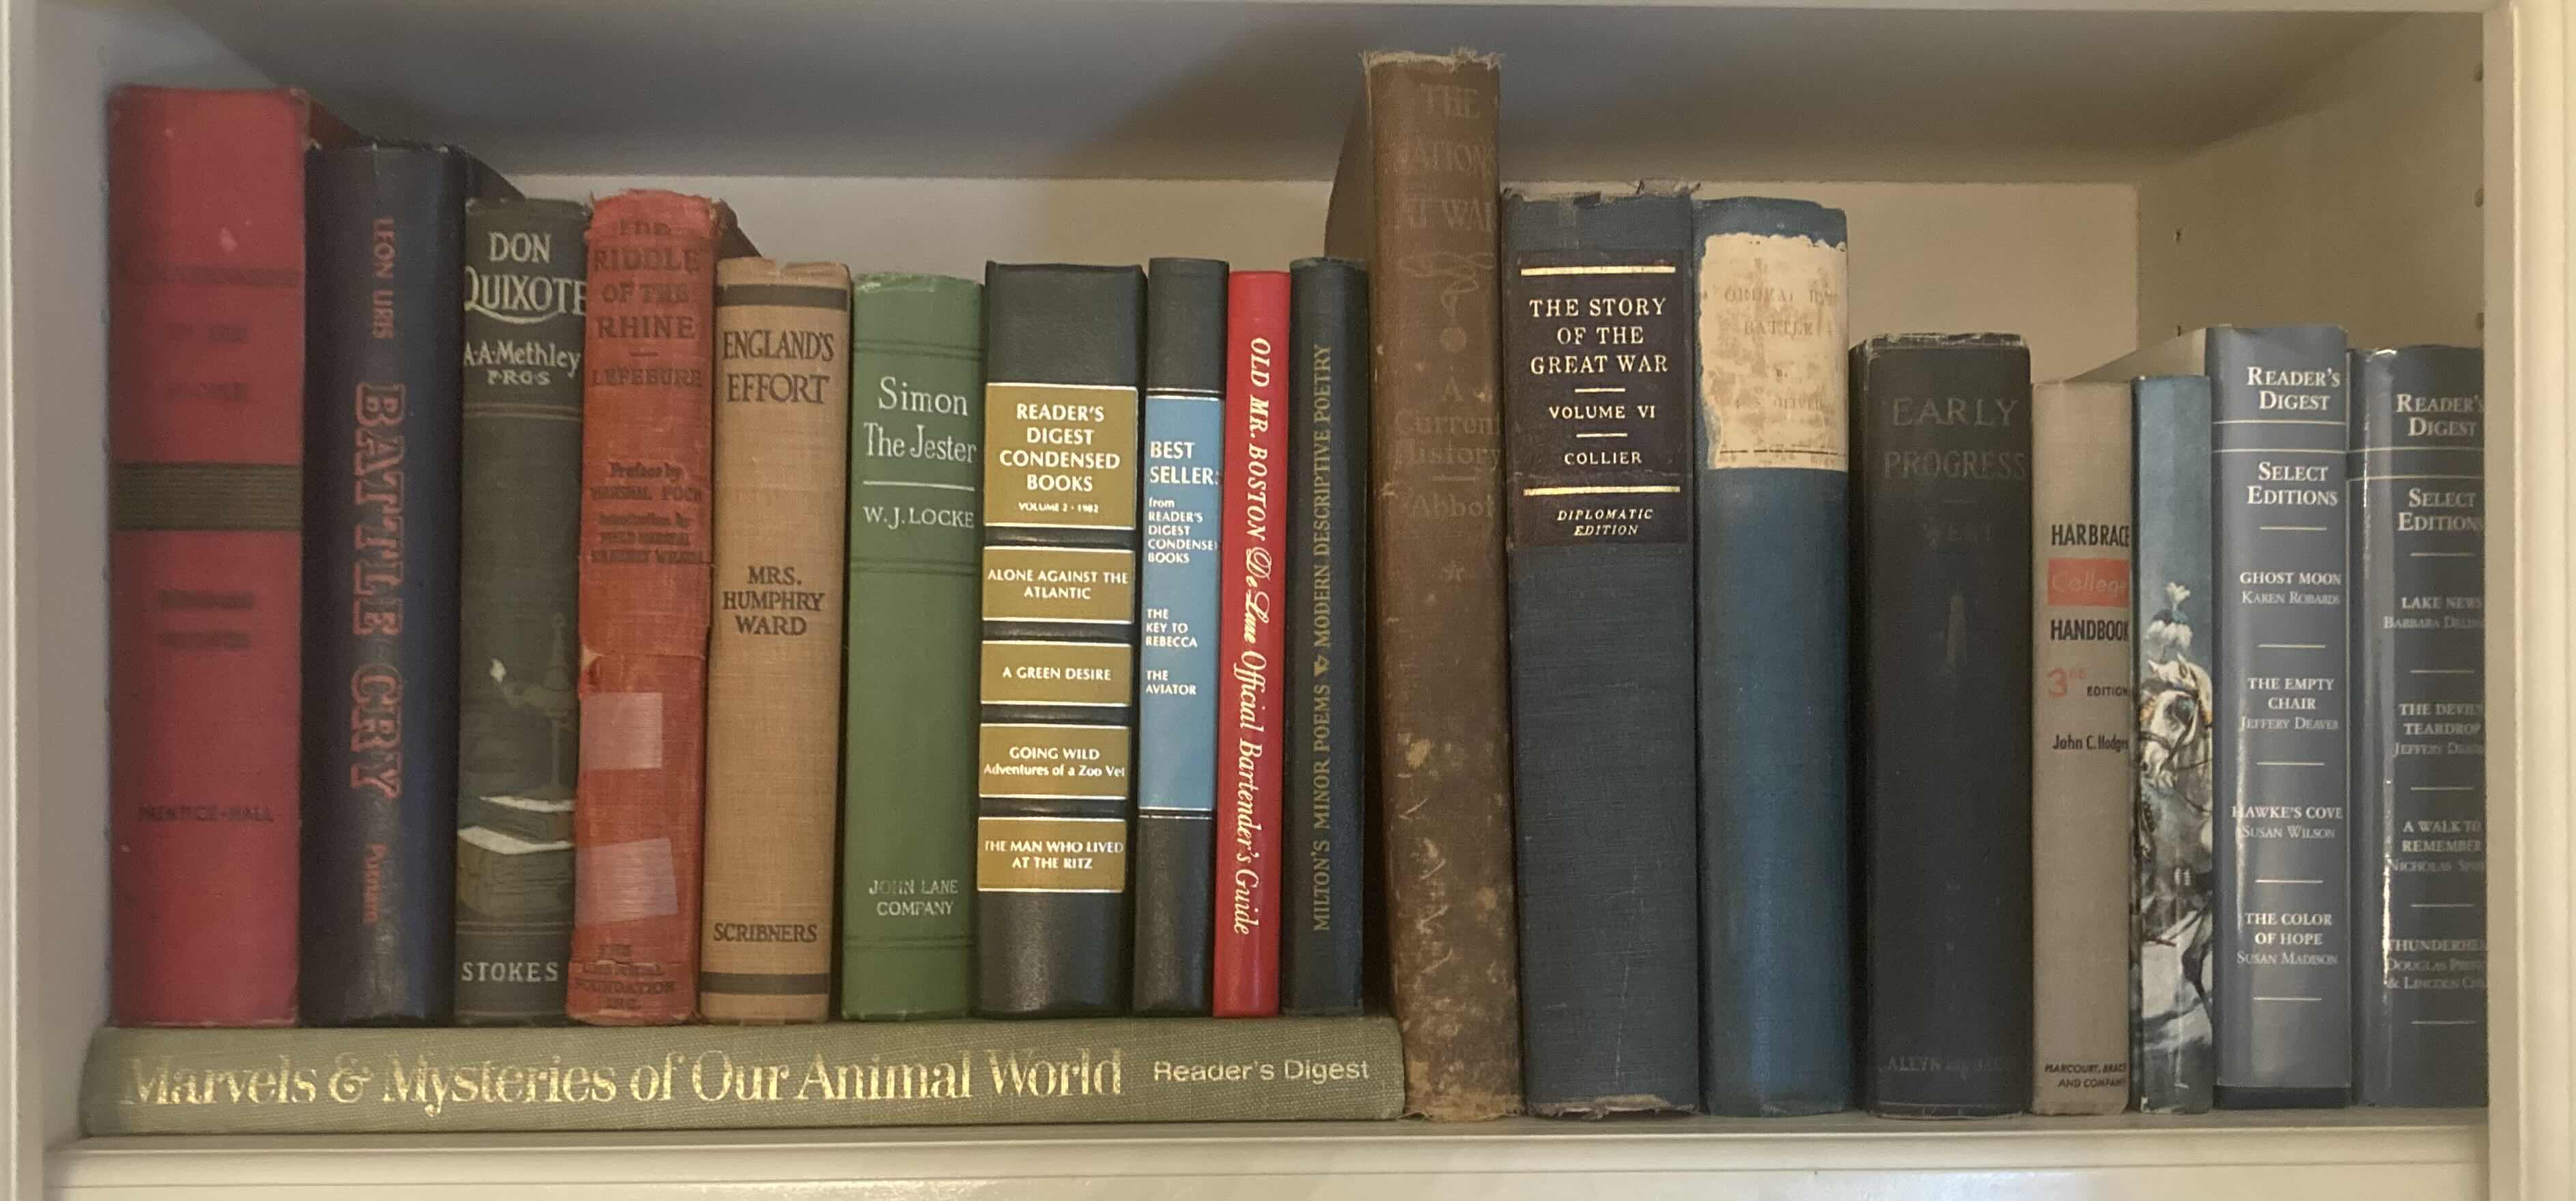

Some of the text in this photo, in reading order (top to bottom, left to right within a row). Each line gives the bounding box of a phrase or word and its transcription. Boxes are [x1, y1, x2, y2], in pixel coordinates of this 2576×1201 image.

[1420, 83, 1481, 120] THE
[488, 230, 551, 263] DON
[593, 247, 701, 273] RIDDLE
[372, 218, 395, 340] LEON URIS
[602, 281, 634, 303] OF
[1529, 297, 1666, 317] THE STORY
[596, 316, 695, 339] RHINE
[1557, 327, 1644, 345] OF THE
[723, 329, 835, 363] ENGLAND'S
[1250, 337, 1271, 388] OLD
[1530, 355, 1668, 375] GREAT WAR
[2246, 367, 2340, 387] READER'S
[726, 372, 830, 404] EFFORT
[878, 376, 968, 417] Simon
[1442, 376, 1465, 402] A
[2259, 391, 2330, 411] DIGEST
[1016, 403, 1105, 422] READER'S
[1249, 394, 1270, 439] MR.
[1549, 404, 1656, 419] VOLUME VI
[1891, 397, 2019, 426] EARLY
[1026, 427, 1095, 445] DIGEST
[2408, 417, 2478, 437] DIGEST
[863, 422, 977, 464] The Jester
[1149, 441, 1195, 459] BEST
[999, 450, 1121, 469] CONDENSED
[1564, 452, 1642, 465] COLLIER
[1884, 450, 2028, 479] PROGRESS
[2258, 462, 2329, 482] SELECT
[1026, 474, 1093, 493] BOOKS
[1246, 444, 1268, 542] BOSTON
[2246, 486, 2338, 507] EDITIONS
[2409, 488, 2477, 508] SELECT
[1018, 502, 1060, 512] VOLUME
[1062, 504, 1068, 512] 2
[1148, 497, 1175, 508] from
[1148, 511, 1204, 523] READER'S
[1557, 508, 1653, 521] DIPLOMATIC
[1147, 525, 1191, 536] DIGEST
[1573, 525, 1639, 536] EDITION
[2051, 525, 2130, 547] HARBRACE
[1147, 553, 1190, 564] BOOKS
[747, 566, 802, 586] MRS.
[988, 568, 1129, 584] ALONE AGAINST THE
[2239, 572, 2342, 585] GHOST MOON
[349, 382, 406, 798] BATTLE CRY
[1024, 586, 1091, 600] ATLANTIC
[2241, 591, 2340, 605] KAREN ROBARDS
[722, 590, 826, 612] HUMPHRY
[2402, 597, 2441, 609] LAKE
[1147, 609, 1169, 619] THE
[734, 615, 808, 636] WARD
[1146, 622, 1189, 633] KEY TO
[2050, 620, 2130, 641] HANDBOOK
[1145, 636, 1197, 647] REBECCA
[1310, 344, 1332, 931] MILTON'S MINOR POEMS MODERN DESCRIPTIVE POETRY
[1002, 667, 1112, 682] A GREEN DESIRE
[1147, 670, 1168, 680] THE
[1146, 684, 1196, 695] AVIATOR
[1233, 650, 1267, 732] Official
[2248, 677, 2335, 691] THE EMPTY
[2267, 698, 2316, 710] CHAIR
[2399, 703, 2431, 715] THE
[2241, 716, 2340, 731] JEFFERY DEAVER
[2403, 723, 2482, 735] TEARDROP
[2052, 735, 2082, 750] John
[2086, 735, 2097, 750] C.
[1009, 747, 1100, 760] GOING WILD
[983, 763, 1126, 777] Adventures of a Zoo Vet
[1236, 737, 1263, 864] Bartender's
[2231, 806, 2343, 820] HAWKE'S COVE
[2241, 825, 2336, 839] SUSAN WILSON
[2403, 820, 2482, 833] A WALK TO
[984, 840, 1125, 853] THE MAN WHO LIVED
[2402, 840, 2483, 853] REMEMBER
[1011, 857, 1093, 869] AT THE RITZ
[869, 879, 959, 896] JOHN LANE
[876, 901, 955, 917] COMPANY
[1233, 867, 1260, 936] Guide
[2245, 913, 2333, 926] THE COLOR
[712, 922, 818, 944] SCRIBNERS
[2254, 933, 2323, 945] OF HOPE
[2237, 951, 2338, 965] SUSAN MADISON
[461, 961, 559, 983] STOKES
[122, 1047, 1371, 1117] Marvels & Mysteries of Our Animal World Reader's Digest
[2058, 1079, 2082, 1088] AND
